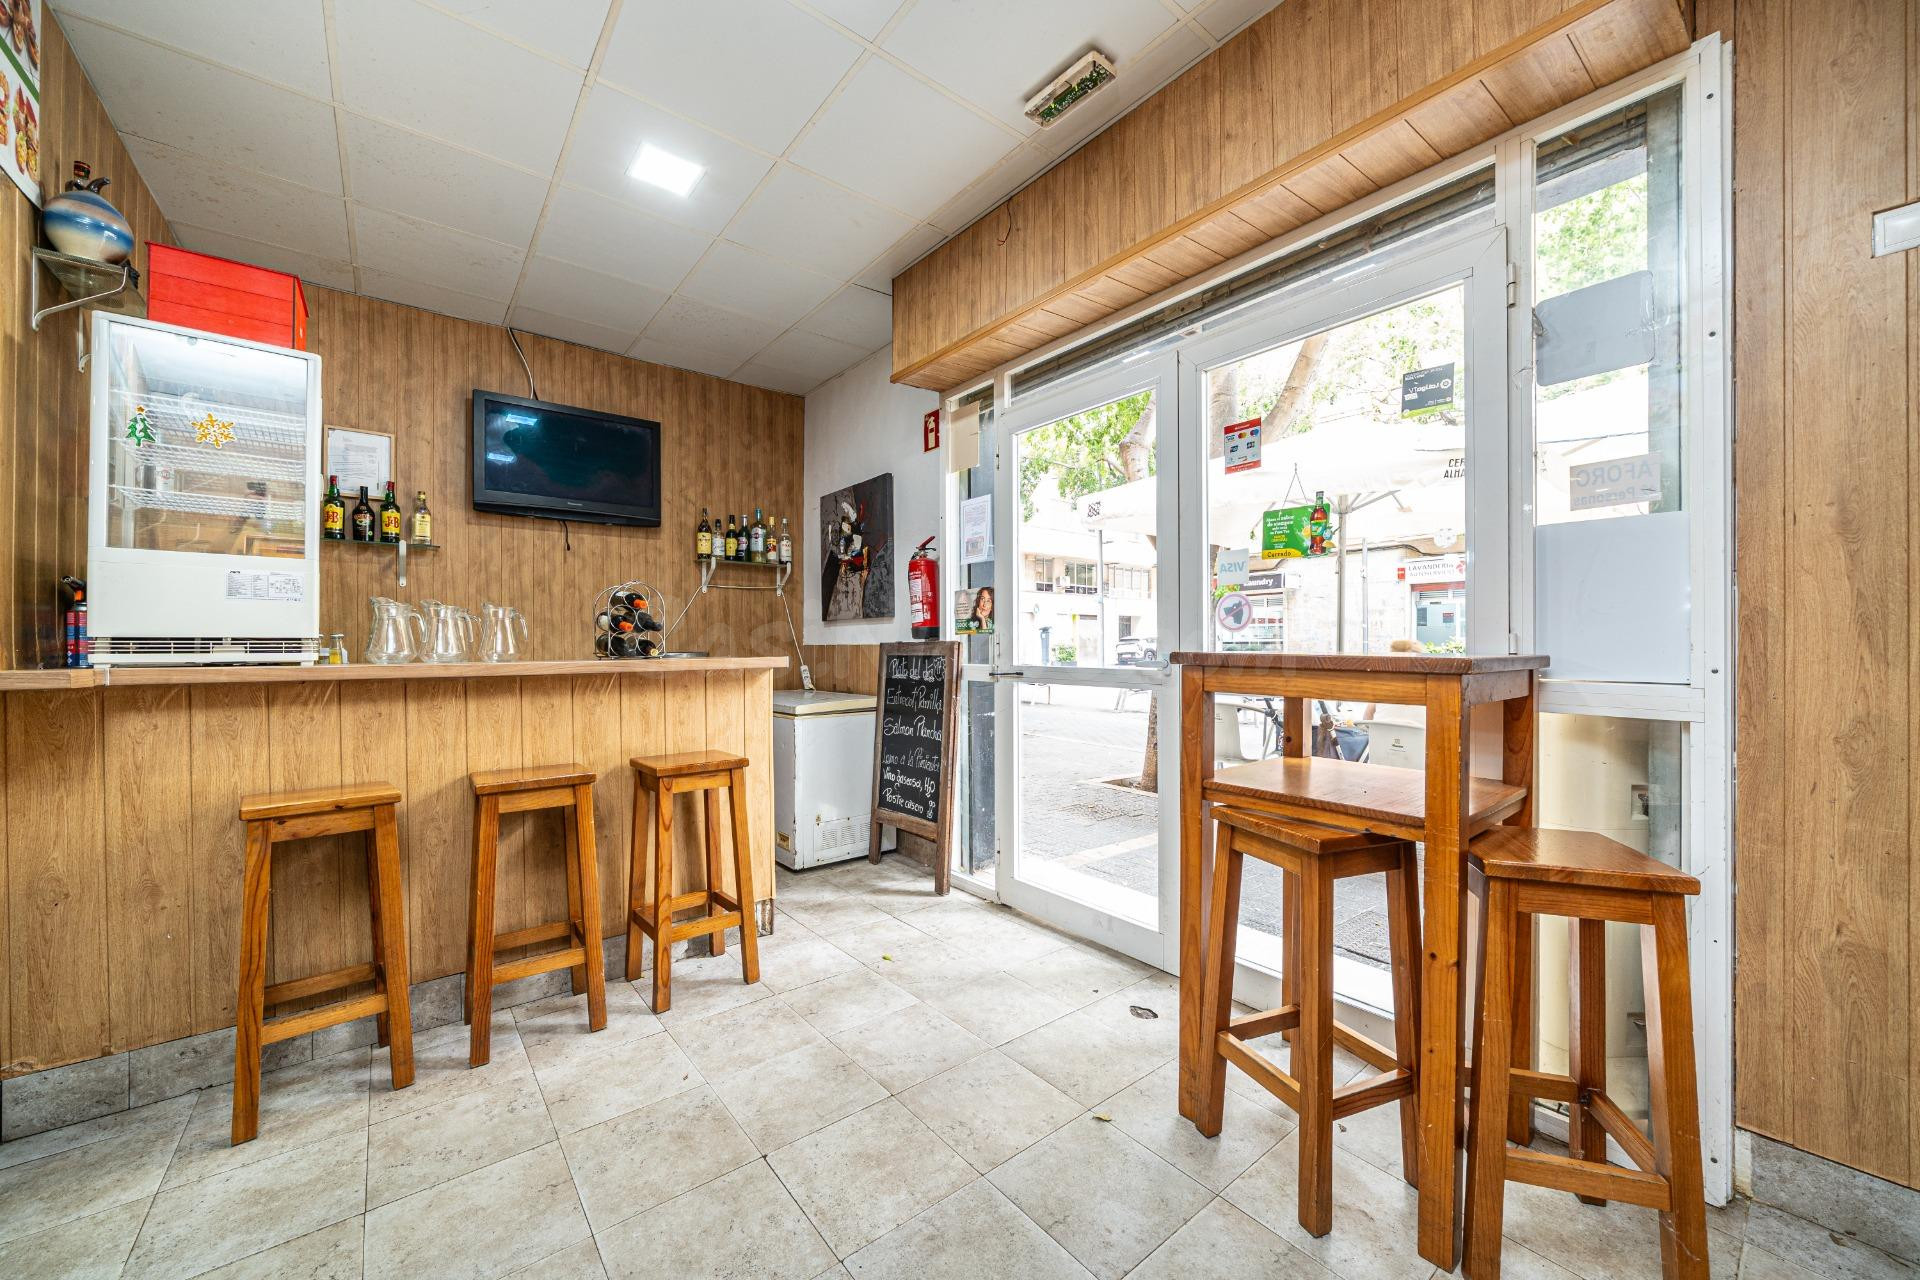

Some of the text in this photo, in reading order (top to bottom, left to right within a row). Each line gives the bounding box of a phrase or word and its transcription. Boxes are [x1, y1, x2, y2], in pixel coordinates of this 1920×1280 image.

[1267, 549, 1292, 558] Cerrado
[1244, 578, 1274, 587] aundry
[909, 656, 920, 676] del
[913, 715, 942, 741] Plancha
[883, 766, 896, 781] Vino
[904, 799, 924, 814] casero
